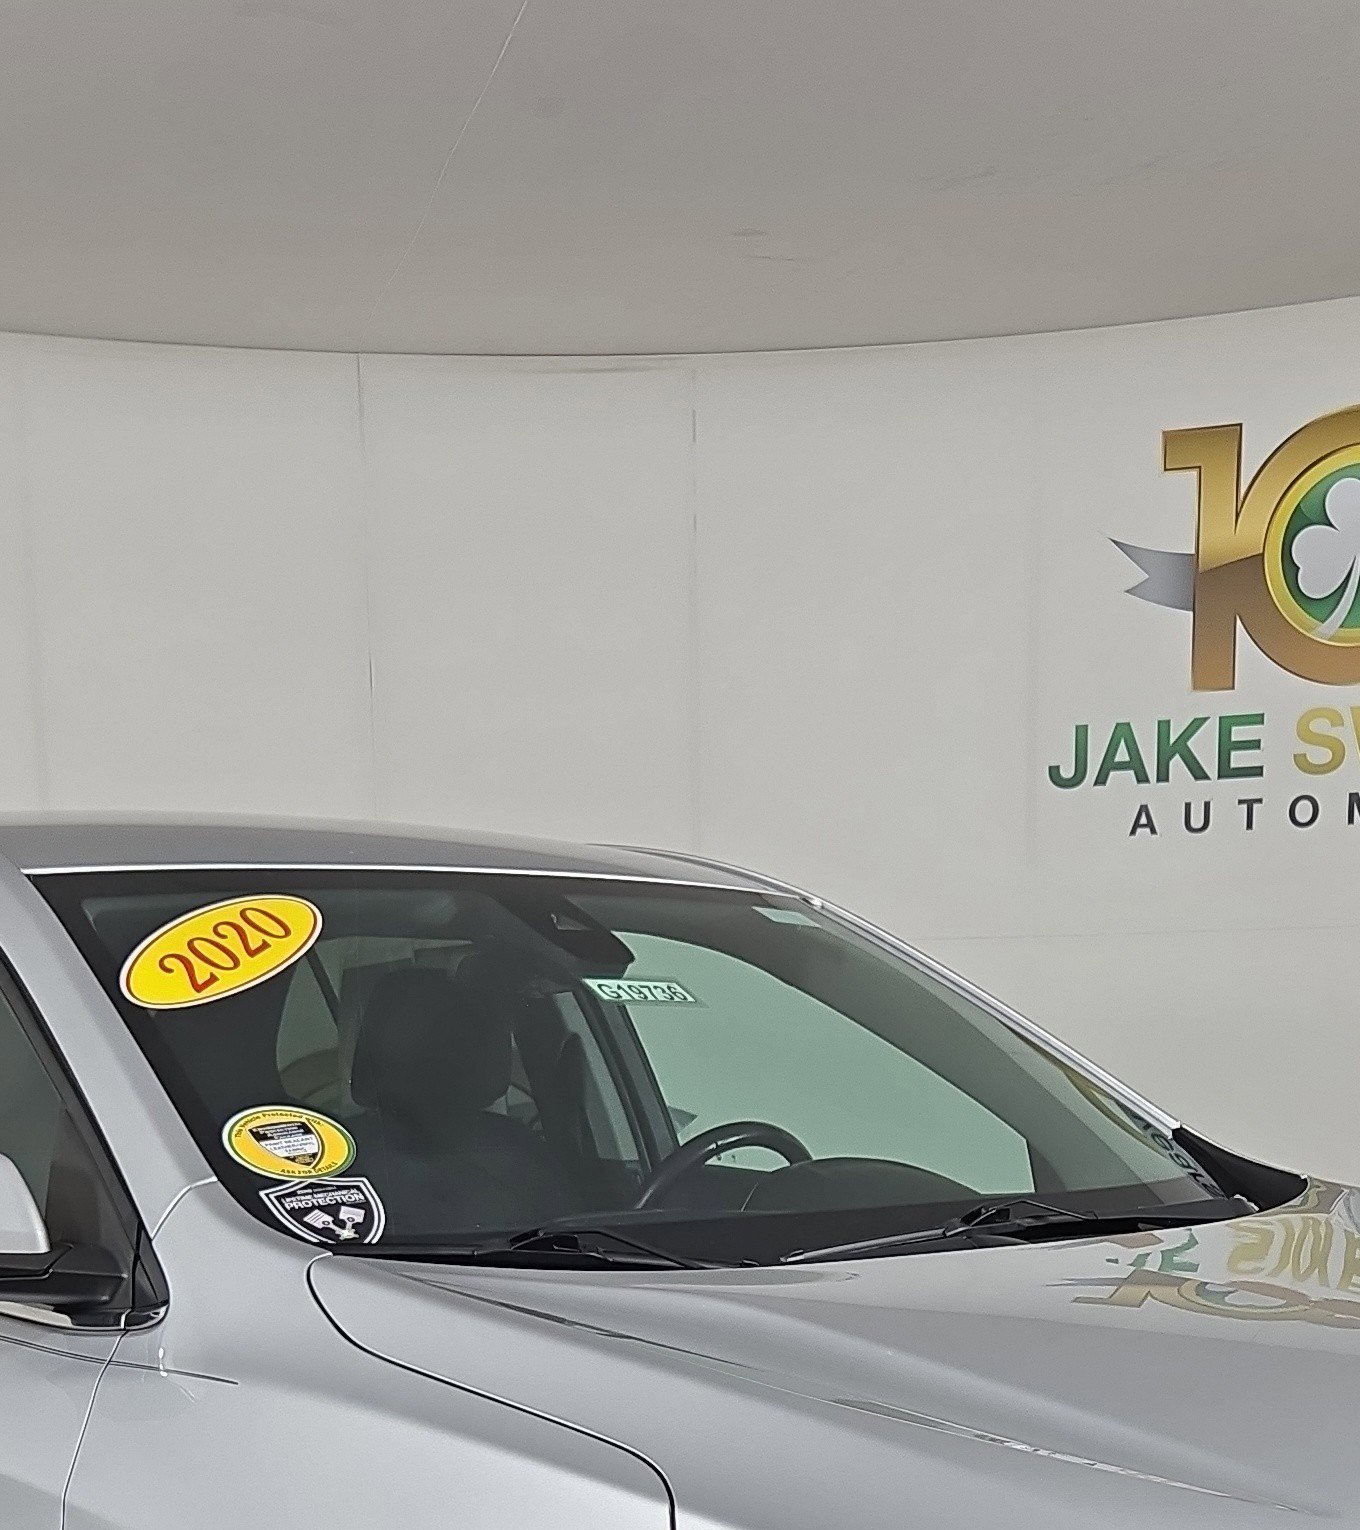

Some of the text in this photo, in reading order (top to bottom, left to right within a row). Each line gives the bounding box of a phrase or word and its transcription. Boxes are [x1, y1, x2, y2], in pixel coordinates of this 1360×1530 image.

[1048, 712, 1264, 790] JAKE
[157, 906, 292, 994] 2020
[597, 984, 688, 1001] G19736
[284, 1194, 365, 1211] PROTECTION
